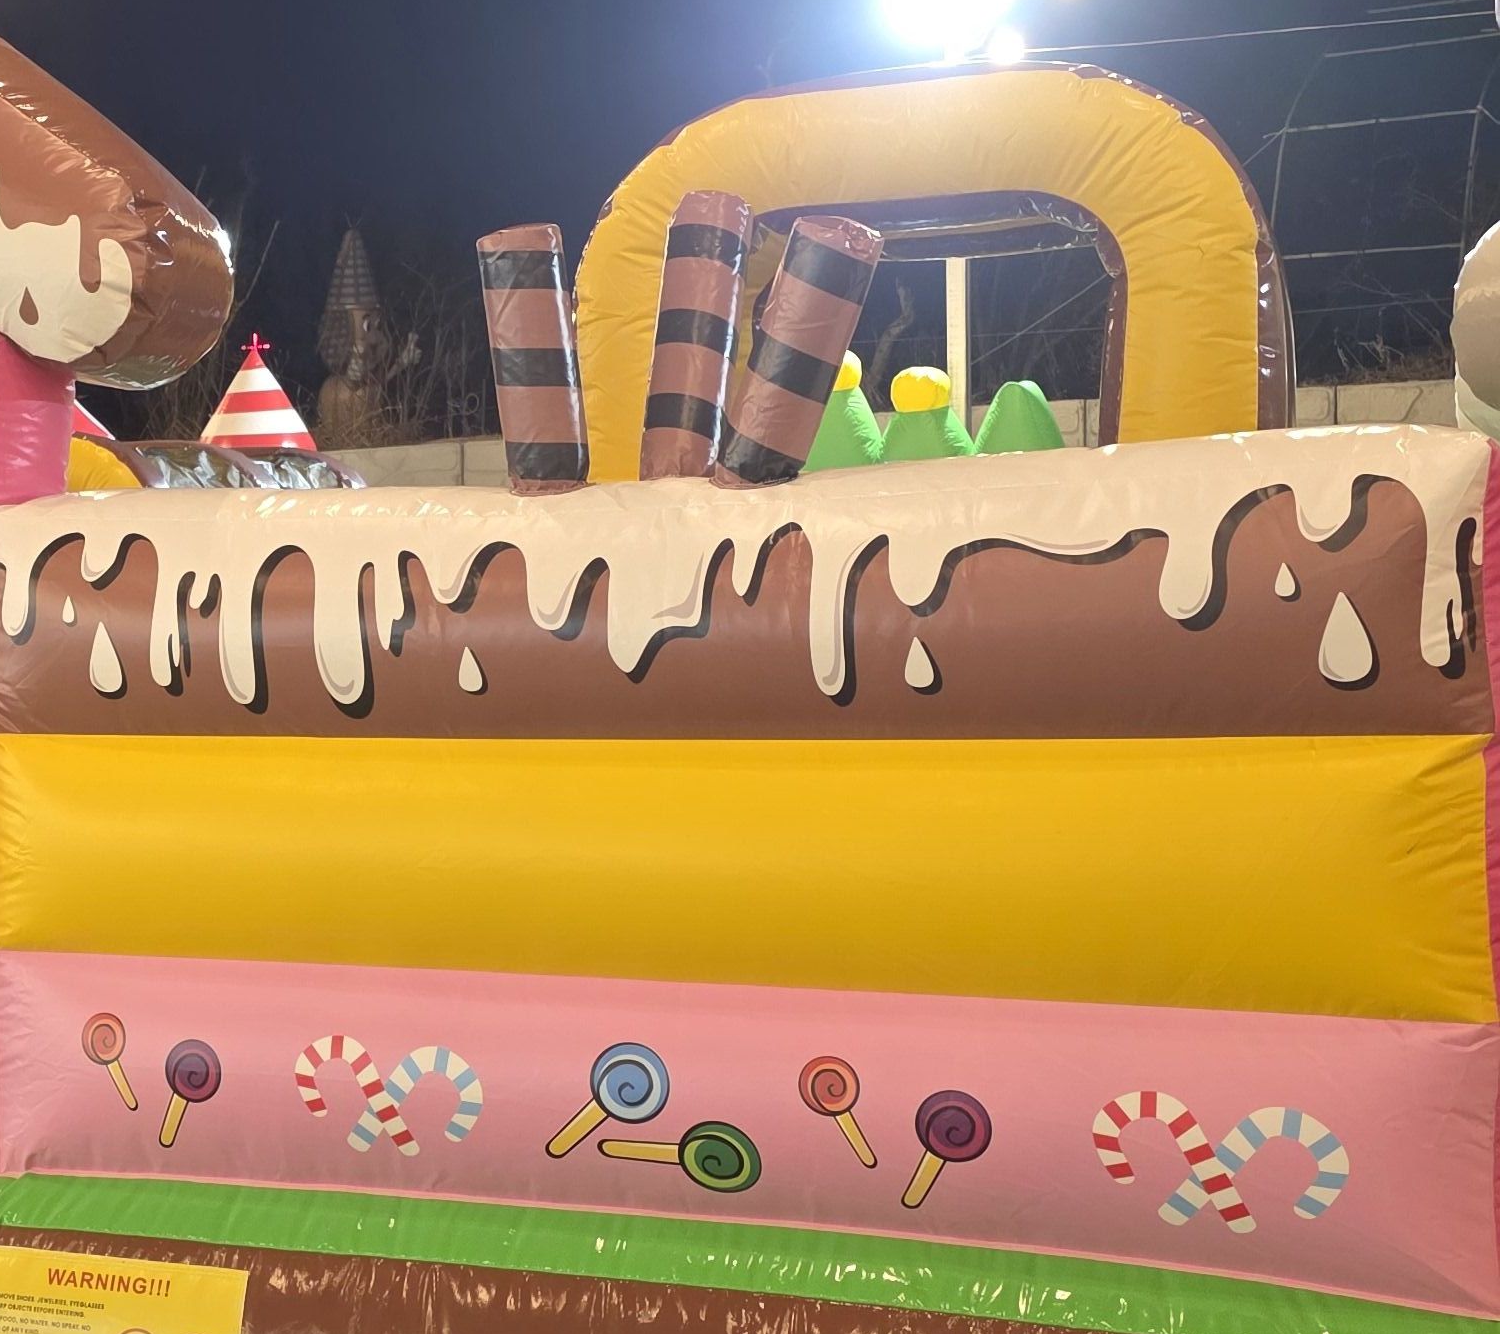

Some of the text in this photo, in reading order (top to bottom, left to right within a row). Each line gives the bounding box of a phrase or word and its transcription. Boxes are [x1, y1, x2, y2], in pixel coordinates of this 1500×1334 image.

[48, 1268, 171, 1298] WARNING!!!
[8, 1303, 32, 1312] OBJECTS
[33, 1306, 54, 1315] BEFORE
[69, 1300, 105, 1310] EYEGLASSES
[19, 1317, 29, 1325] NO
[51, 1321, 61, 1329] NO
[81, 1324, 92, 1332] NO
